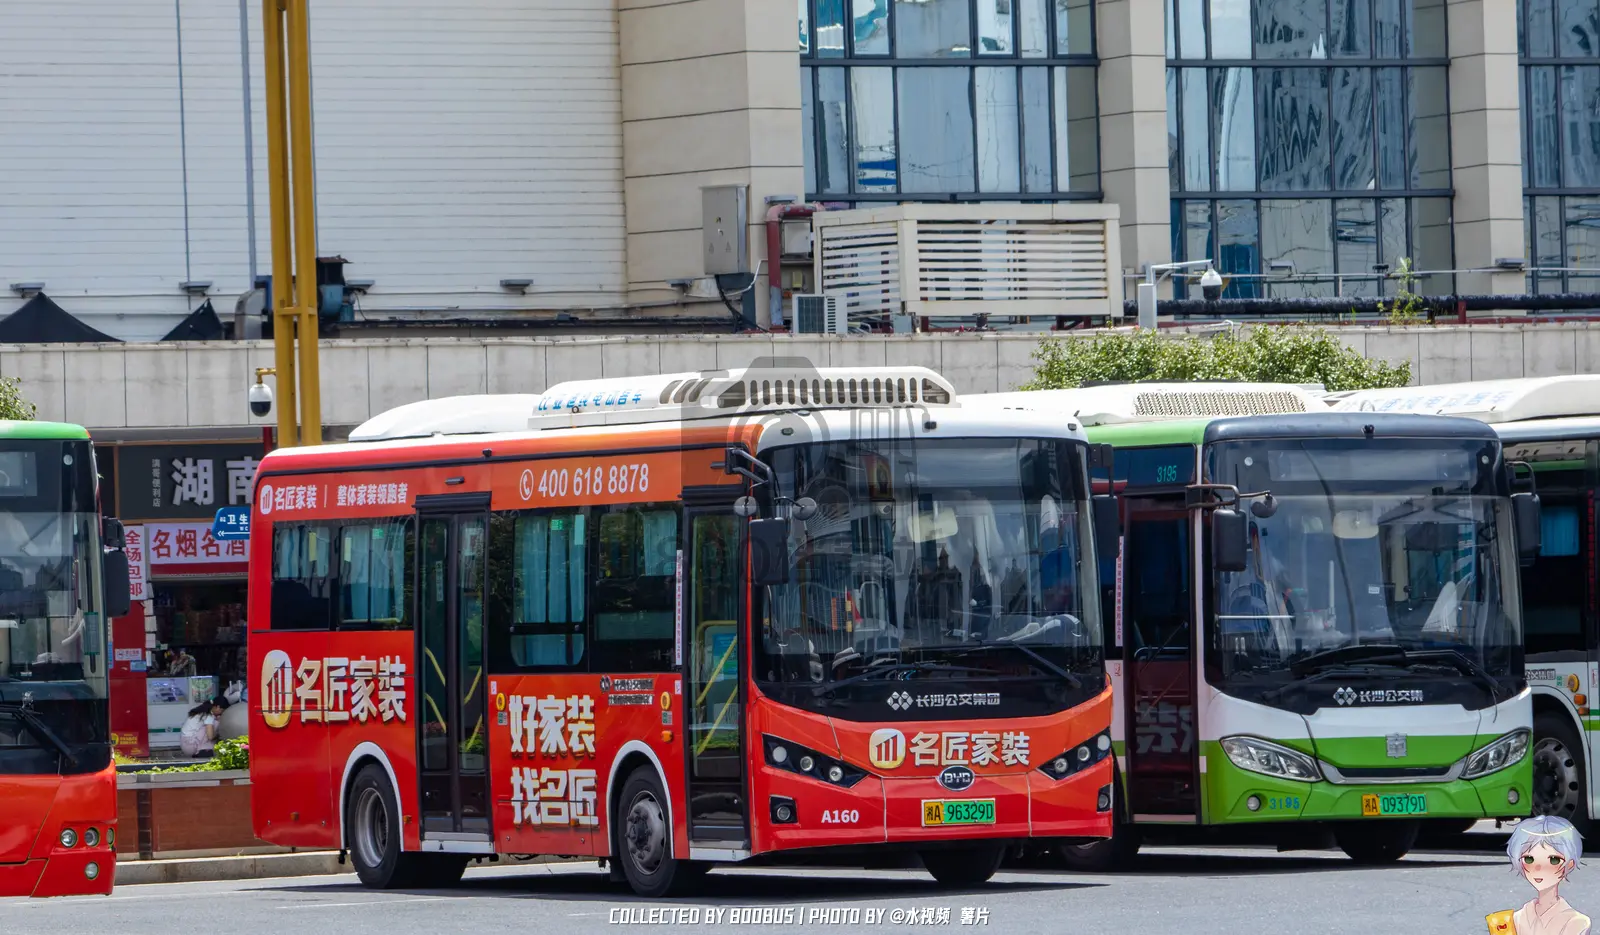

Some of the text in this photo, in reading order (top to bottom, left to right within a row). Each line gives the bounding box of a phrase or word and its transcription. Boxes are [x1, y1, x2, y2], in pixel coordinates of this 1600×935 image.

[171, 456, 256, 506] 湖南
[538, 462, 650, 498] 400 618 8878
[1156, 464, 1177, 483] 3195
[274, 484, 317, 511] 名匠家装
[336, 481, 409, 507] 整体家装领跑者
[295, 656, 407, 724] 名匠家装
[916, 692, 1001, 708] 长沙公交集团
[508, 694, 597, 754] 好家装
[909, 731, 1031, 767] 名匠家装
[944, 772, 971, 784] BYD
[510, 766, 599, 826] 找名匠
[1268, 797, 1300, 810] 3195
[821, 809, 860, 824] A160
